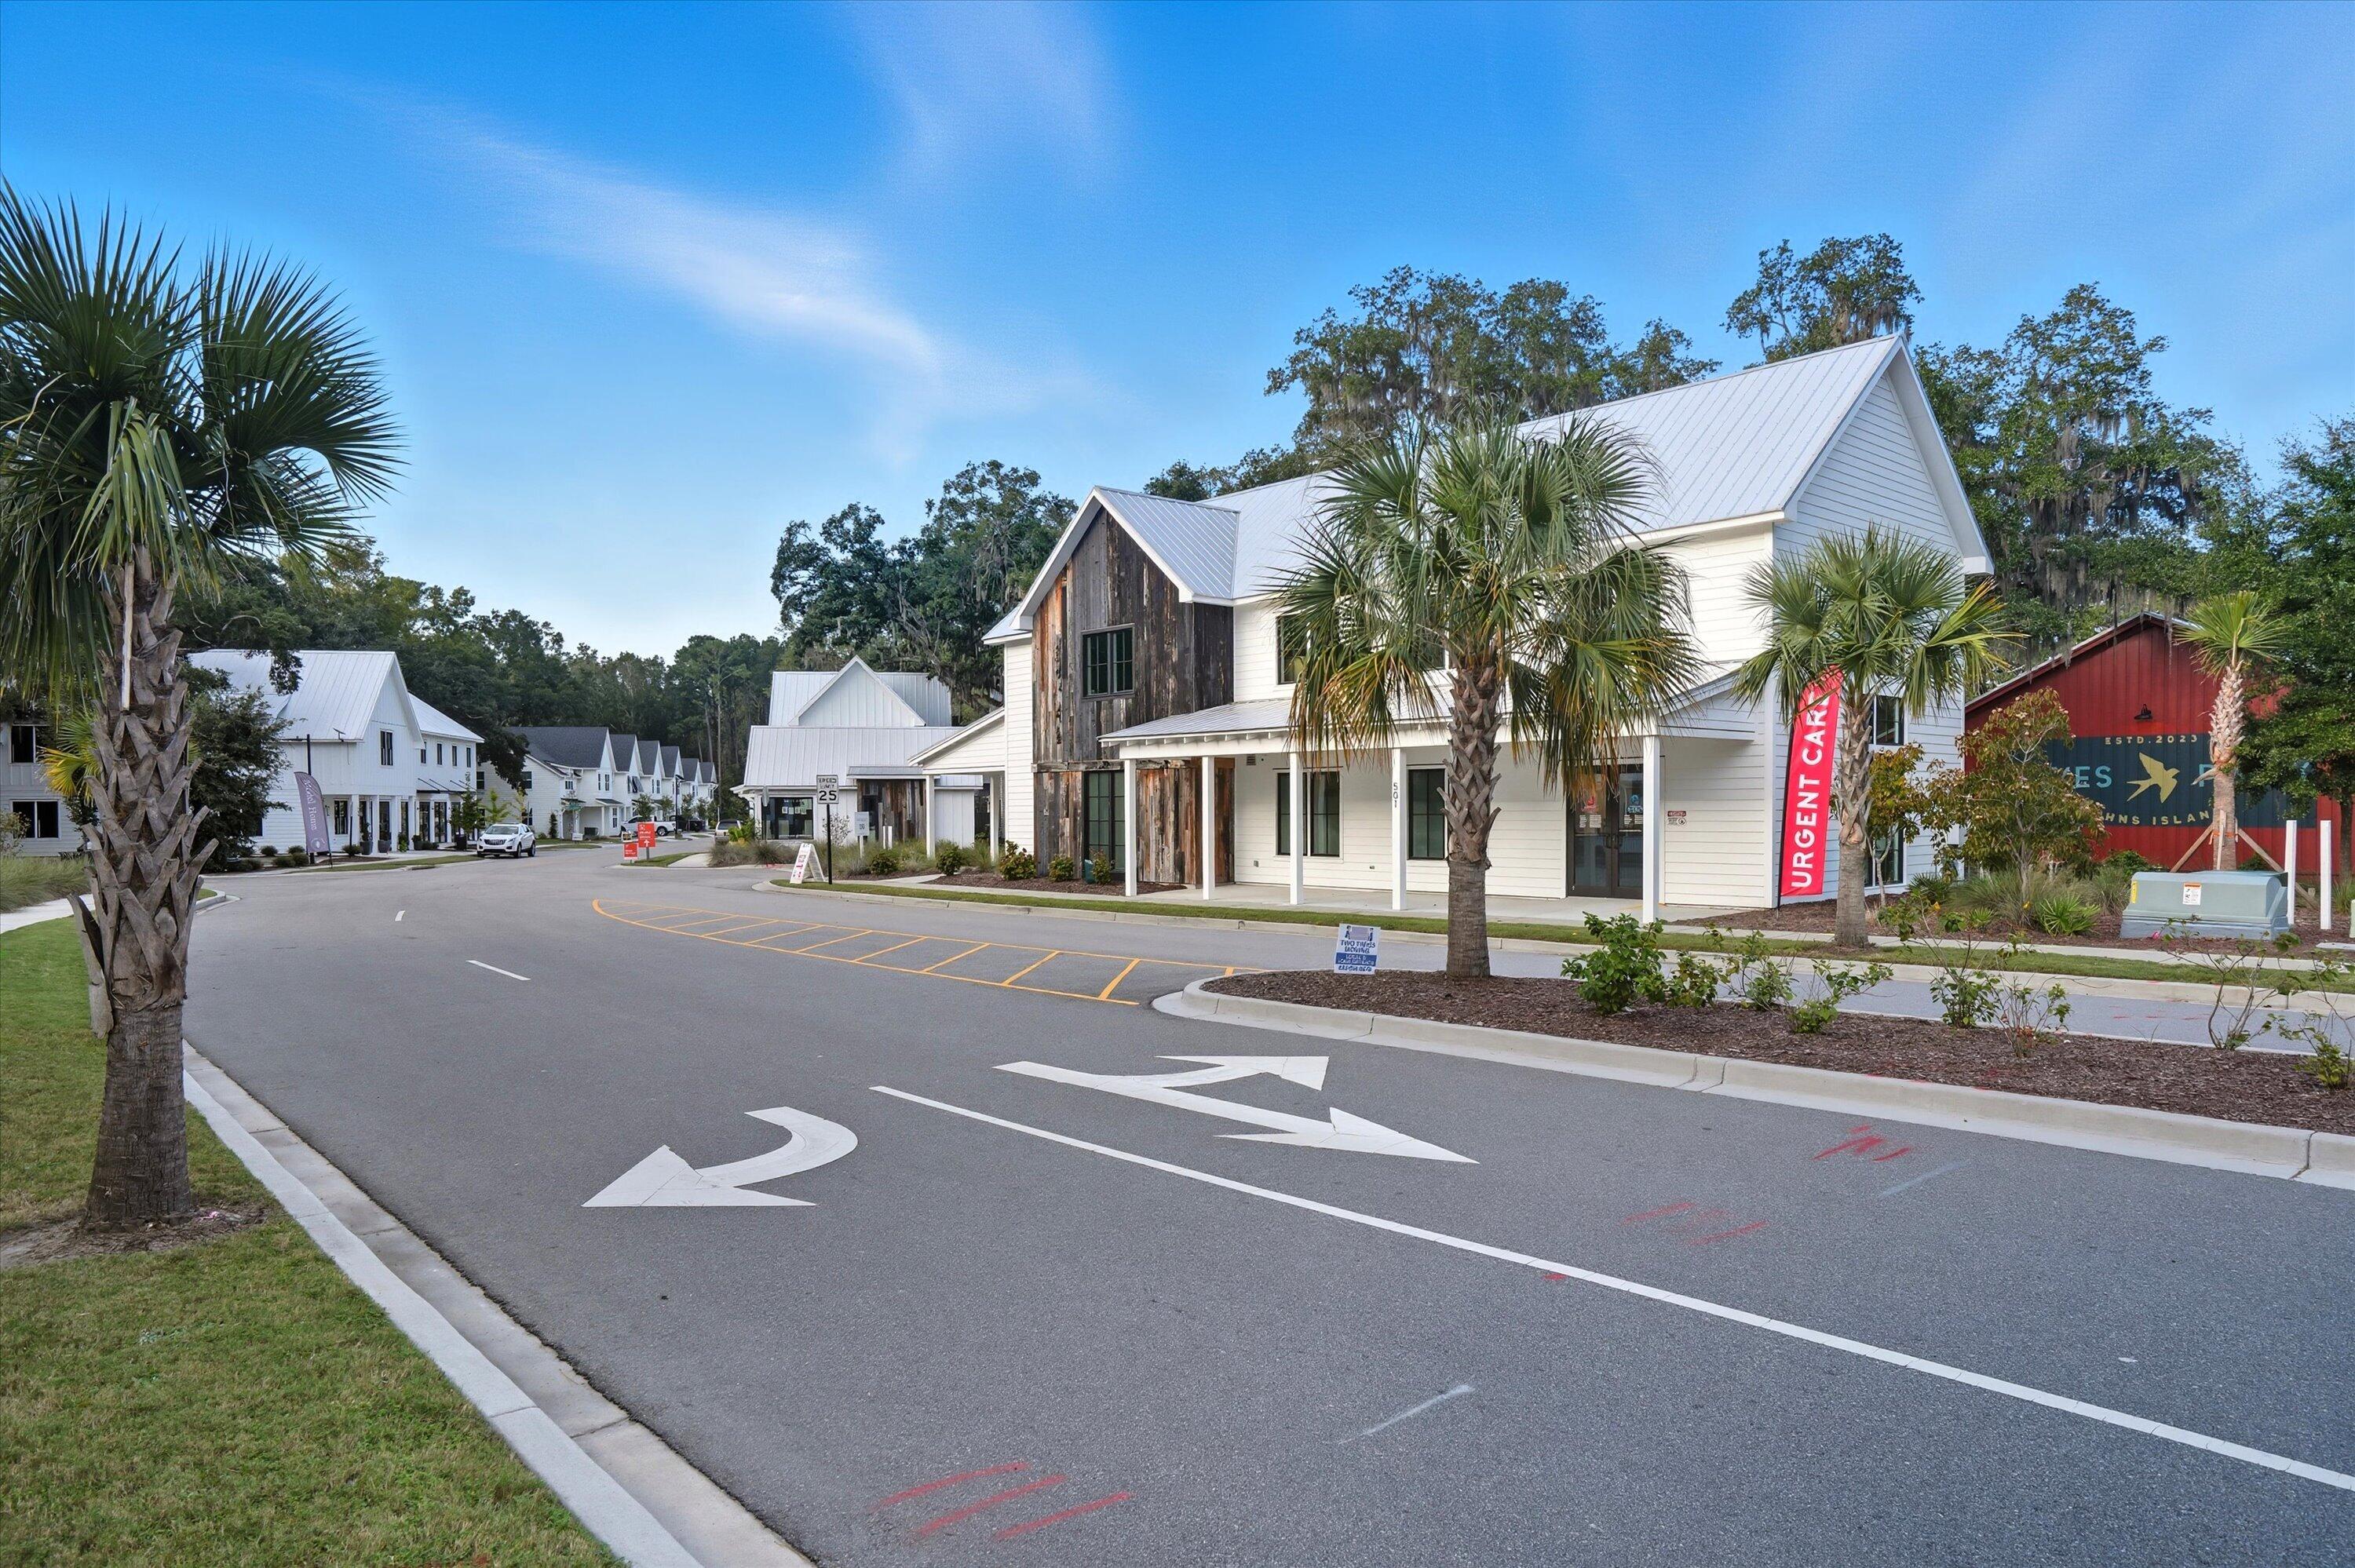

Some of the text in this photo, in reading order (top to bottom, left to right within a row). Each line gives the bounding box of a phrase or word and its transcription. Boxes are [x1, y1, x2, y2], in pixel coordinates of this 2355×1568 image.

[819, 790, 837, 800] 25
[2152, 810, 2210, 825] ISLAN
[1791, 774, 1820, 888] URGENT
